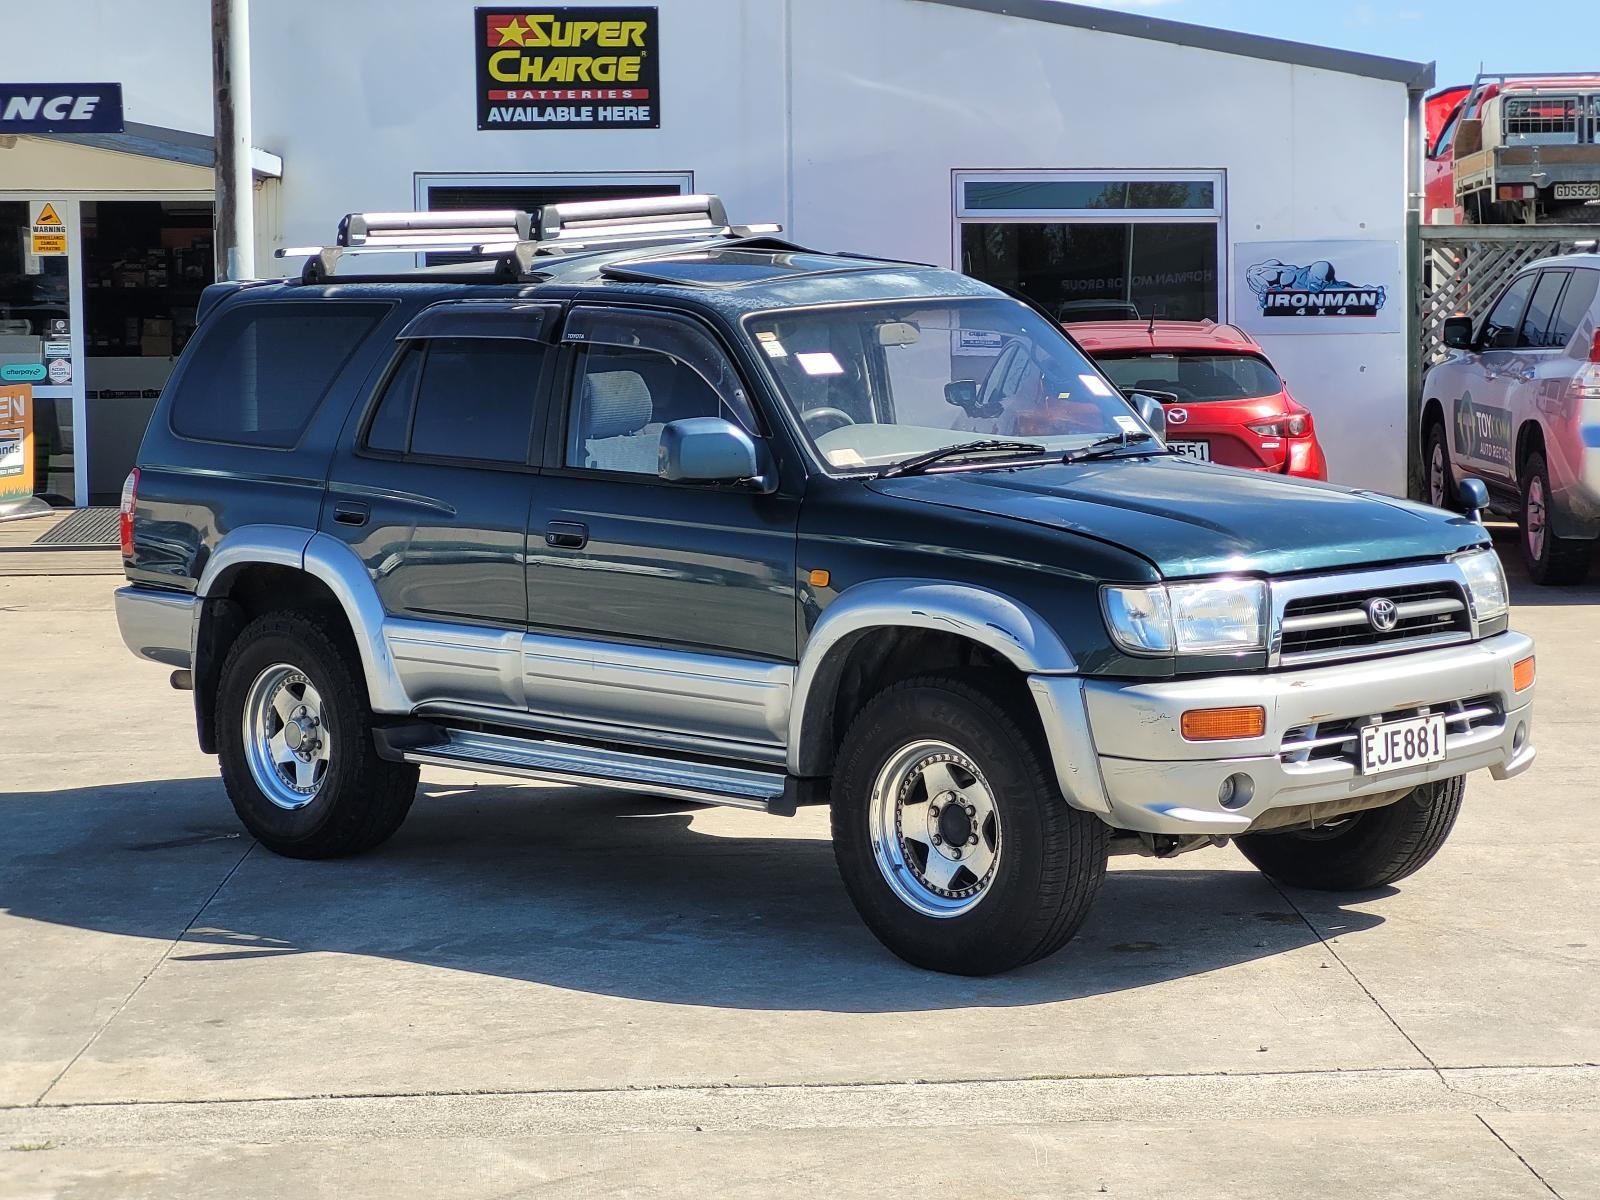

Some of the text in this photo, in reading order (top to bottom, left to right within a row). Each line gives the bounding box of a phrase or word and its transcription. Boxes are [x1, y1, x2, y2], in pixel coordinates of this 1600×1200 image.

[525, 14, 648, 47] SUPER
[488, 49, 641, 82] CHARGE
[506, 90, 633, 100] BATTERIES
[2, 96, 100, 121] NCE
[487, 105, 650, 122] AVAILABLE HERE
[1556, 185, 1599, 197] GDS523
[1267, 292, 1377, 307] IRONMAN
[1296, 307, 1306, 315] 4
[1337, 307, 1347, 315] 4
[6, 368, 33, 376] afterpay
[0, 443, 21, 456] nds
[1364, 723, 1440, 769] EJE881
